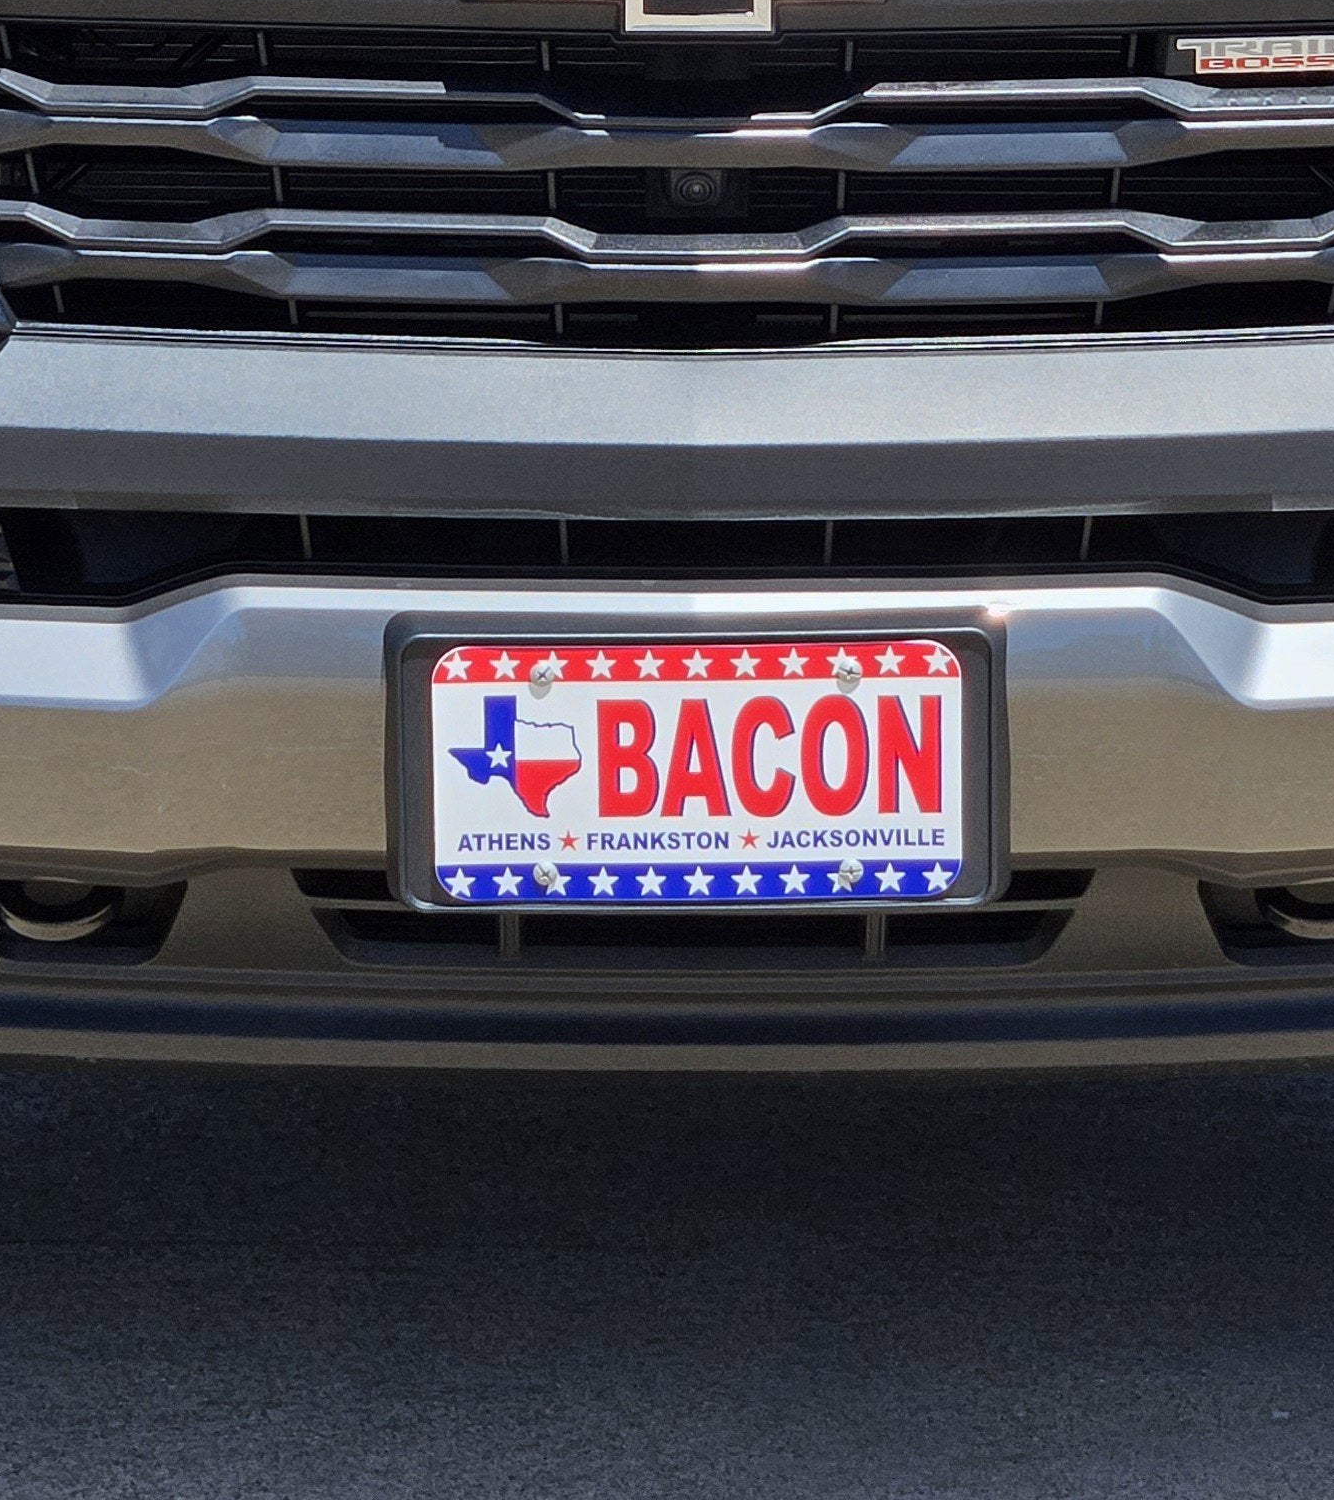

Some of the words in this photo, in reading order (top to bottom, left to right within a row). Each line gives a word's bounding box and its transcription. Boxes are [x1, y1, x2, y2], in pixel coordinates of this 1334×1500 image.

[597, 694, 942, 818] BACON
[457, 833, 551, 851] ATHENS
[586, 831, 730, 850] FRANKSTON
[766, 829, 946, 849] JACKSONVILLE
